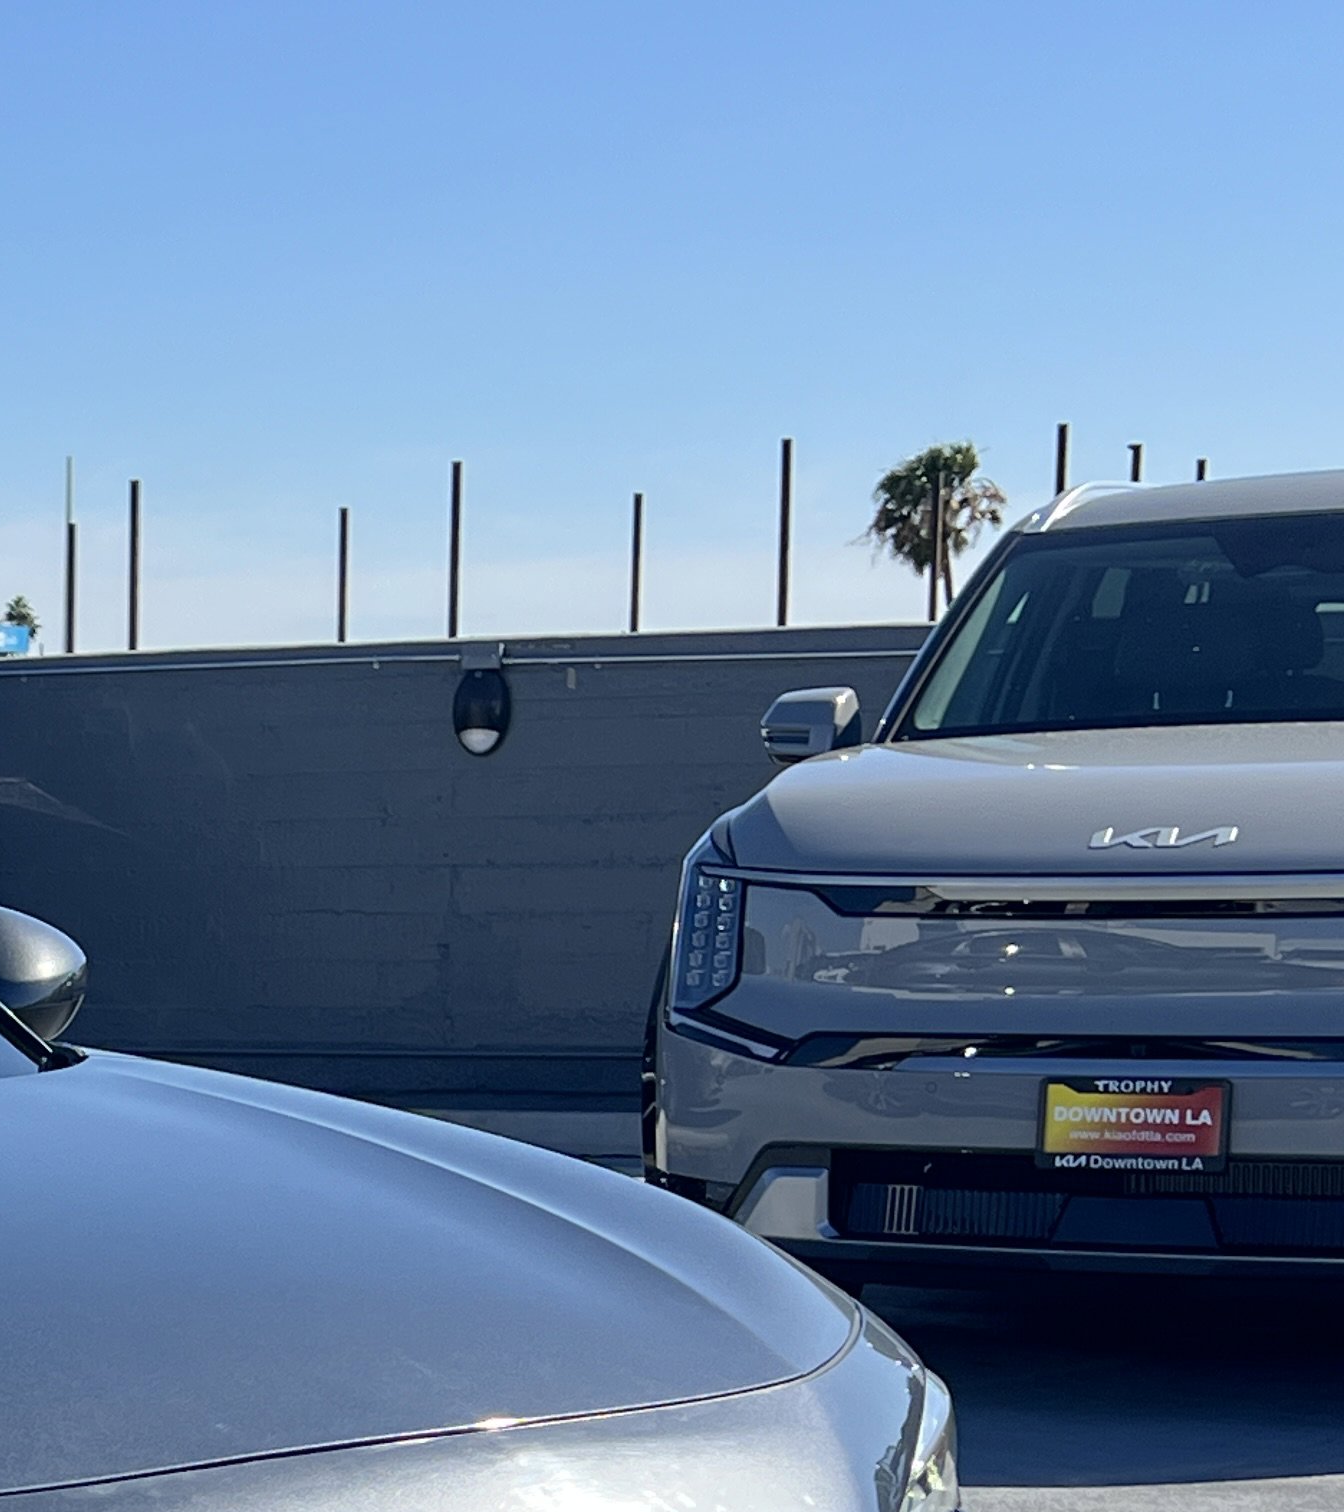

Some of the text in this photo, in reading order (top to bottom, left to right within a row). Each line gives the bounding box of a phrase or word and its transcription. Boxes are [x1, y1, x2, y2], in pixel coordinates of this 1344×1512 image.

[1094, 1080, 1172, 1093] TROPHY
[1053, 1106, 1213, 1126] DOWNTOWN LA
[1089, 1155, 1179, 1170] Downtown
[1181, 1158, 1204, 1171] LA
